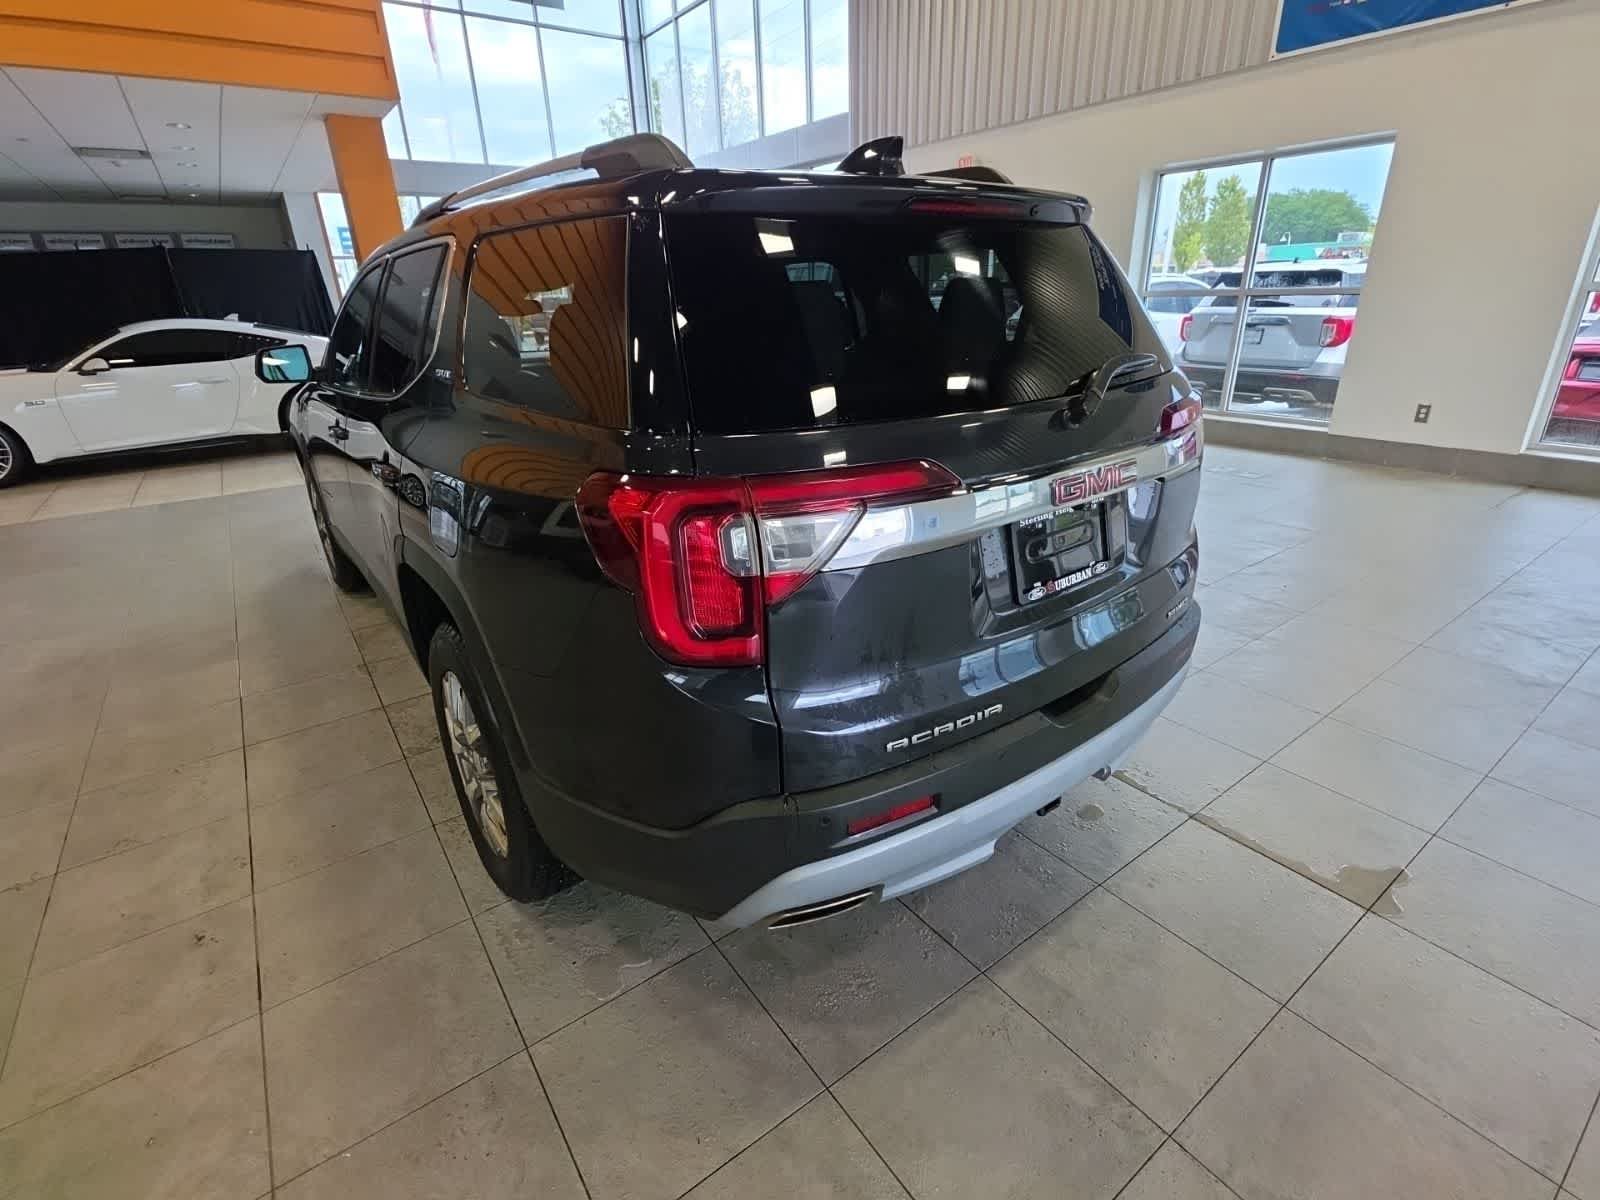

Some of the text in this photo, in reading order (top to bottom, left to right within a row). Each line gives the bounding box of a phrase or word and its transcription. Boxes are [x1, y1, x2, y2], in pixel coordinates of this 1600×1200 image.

[1052, 458, 1137, 507] GMC
[1046, 566, 1093, 593] SUBURBAN
[886, 703, 1003, 753] ACADIA
